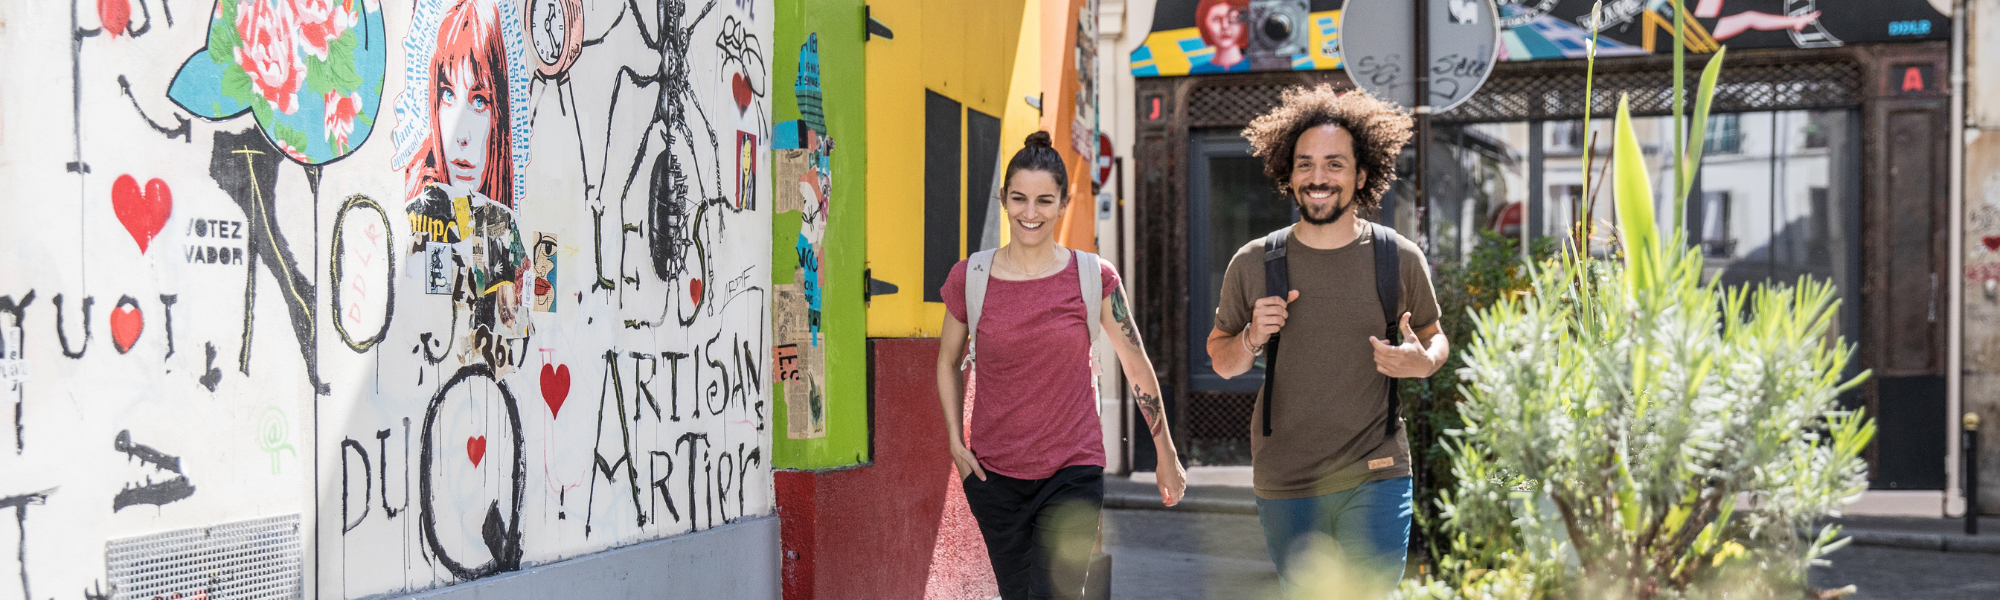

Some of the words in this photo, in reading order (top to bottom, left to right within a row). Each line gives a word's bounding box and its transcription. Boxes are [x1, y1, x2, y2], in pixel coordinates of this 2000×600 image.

[1902, 67, 1924, 91] A
[1149, 97, 1160, 119] J
[393, 119, 416, 150] Jane
[183, 245, 243, 265] VADOR
[341, 416, 413, 536] DU
